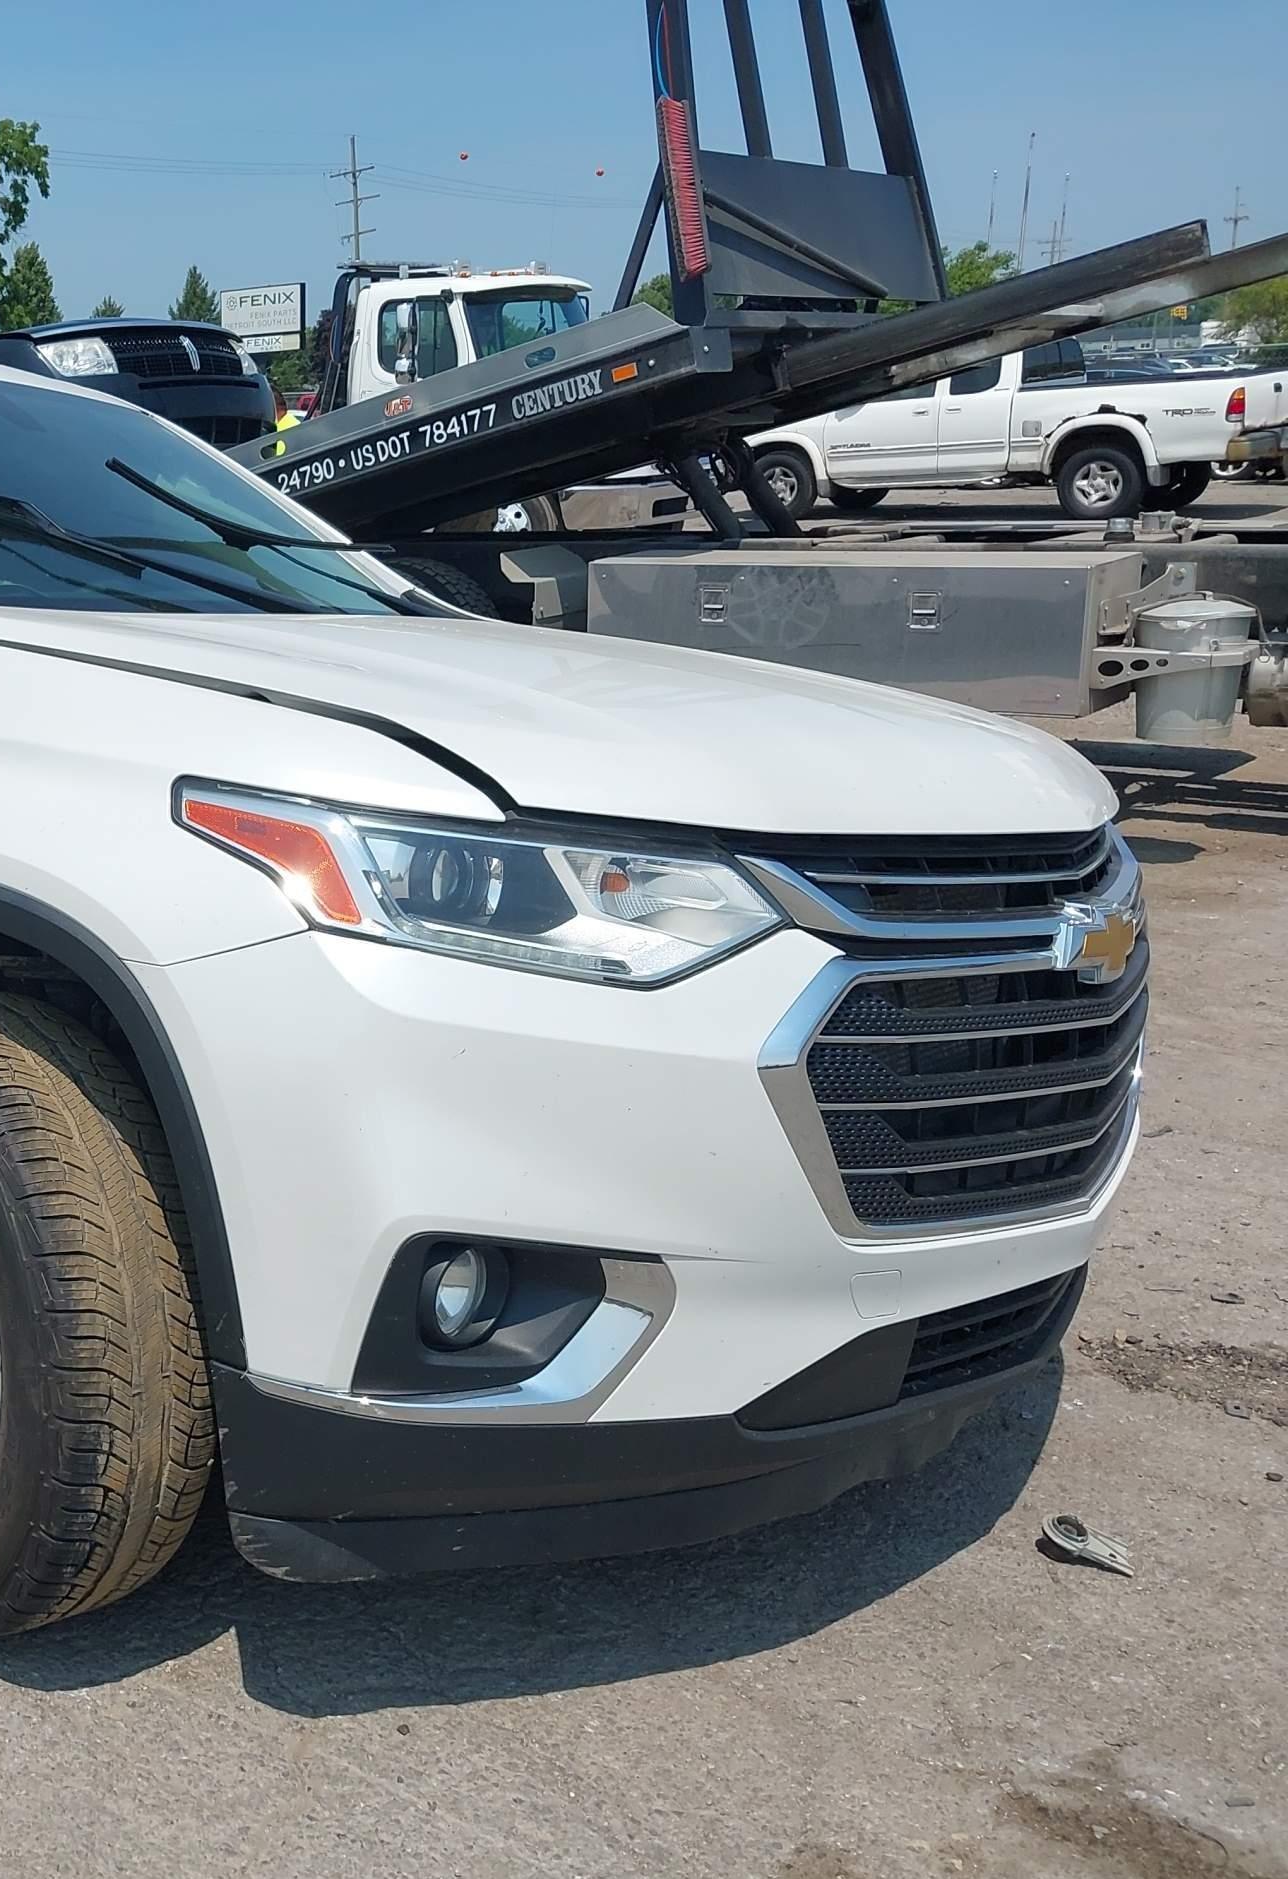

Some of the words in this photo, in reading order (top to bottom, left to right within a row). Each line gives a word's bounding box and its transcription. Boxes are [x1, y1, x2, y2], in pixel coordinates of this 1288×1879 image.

[239, 291, 294, 308] FENIX
[250, 310, 271, 319] FENIX
[274, 309, 297, 318] PARTS
[258, 319, 282, 327] SOUTH
[283, 317, 297, 326] LLC
[246, 337, 281, 347] FENIX
[511, 369, 603, 419] CENTURY
[277, 458, 335, 494] 24790
[418, 404, 497, 448] 784177
